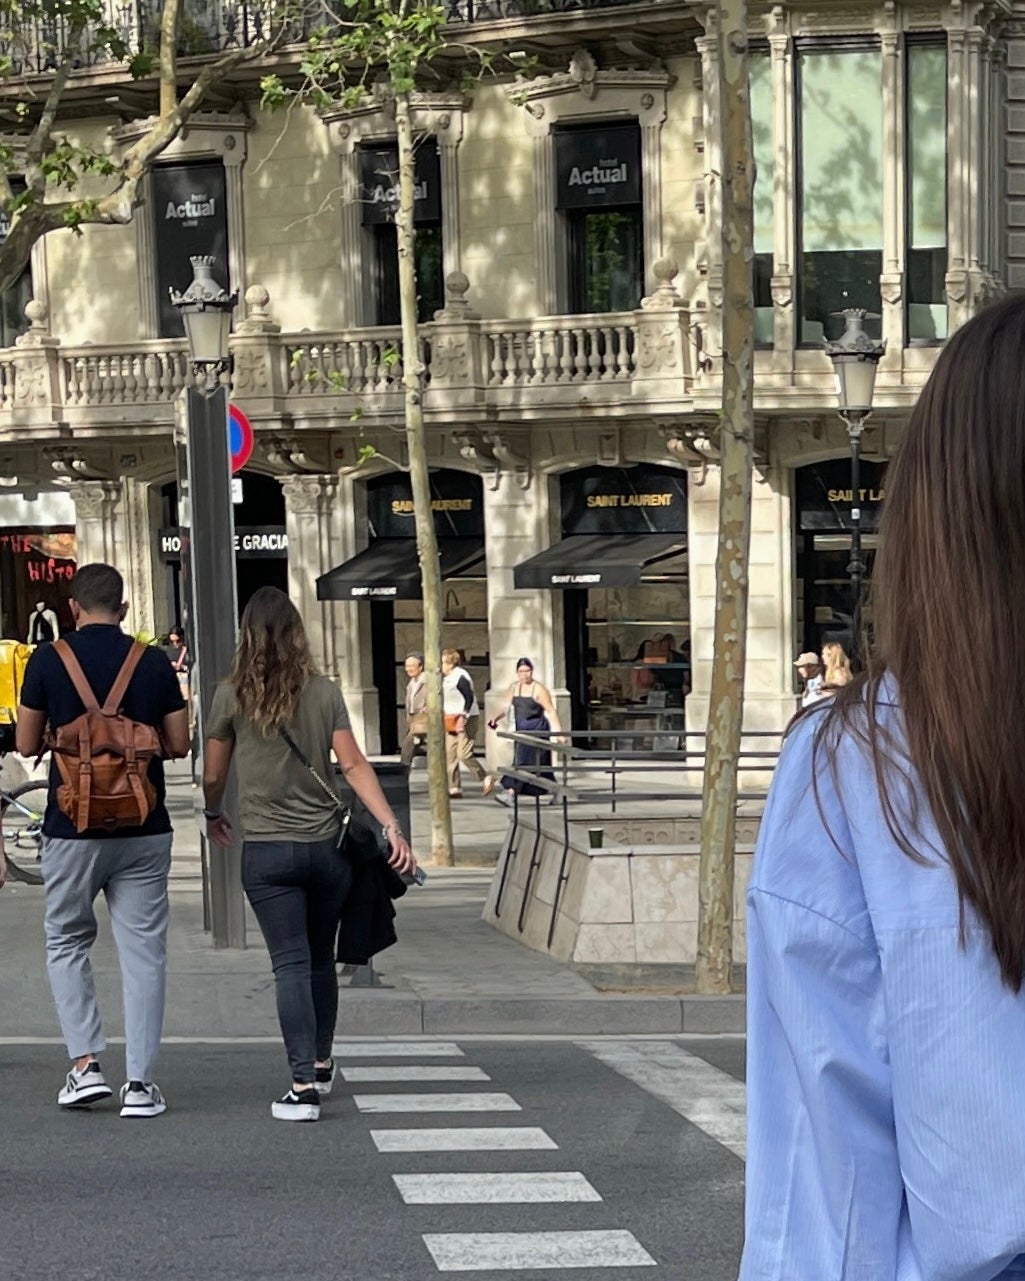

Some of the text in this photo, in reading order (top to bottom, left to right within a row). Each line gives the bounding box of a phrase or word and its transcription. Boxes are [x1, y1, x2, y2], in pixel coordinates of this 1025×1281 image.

[568, 163, 627, 186] Actual
[374, 181, 427, 202] Actal
[165, 198, 215, 220] Actual
[587, 493, 673, 507] SAINT LAURENT
